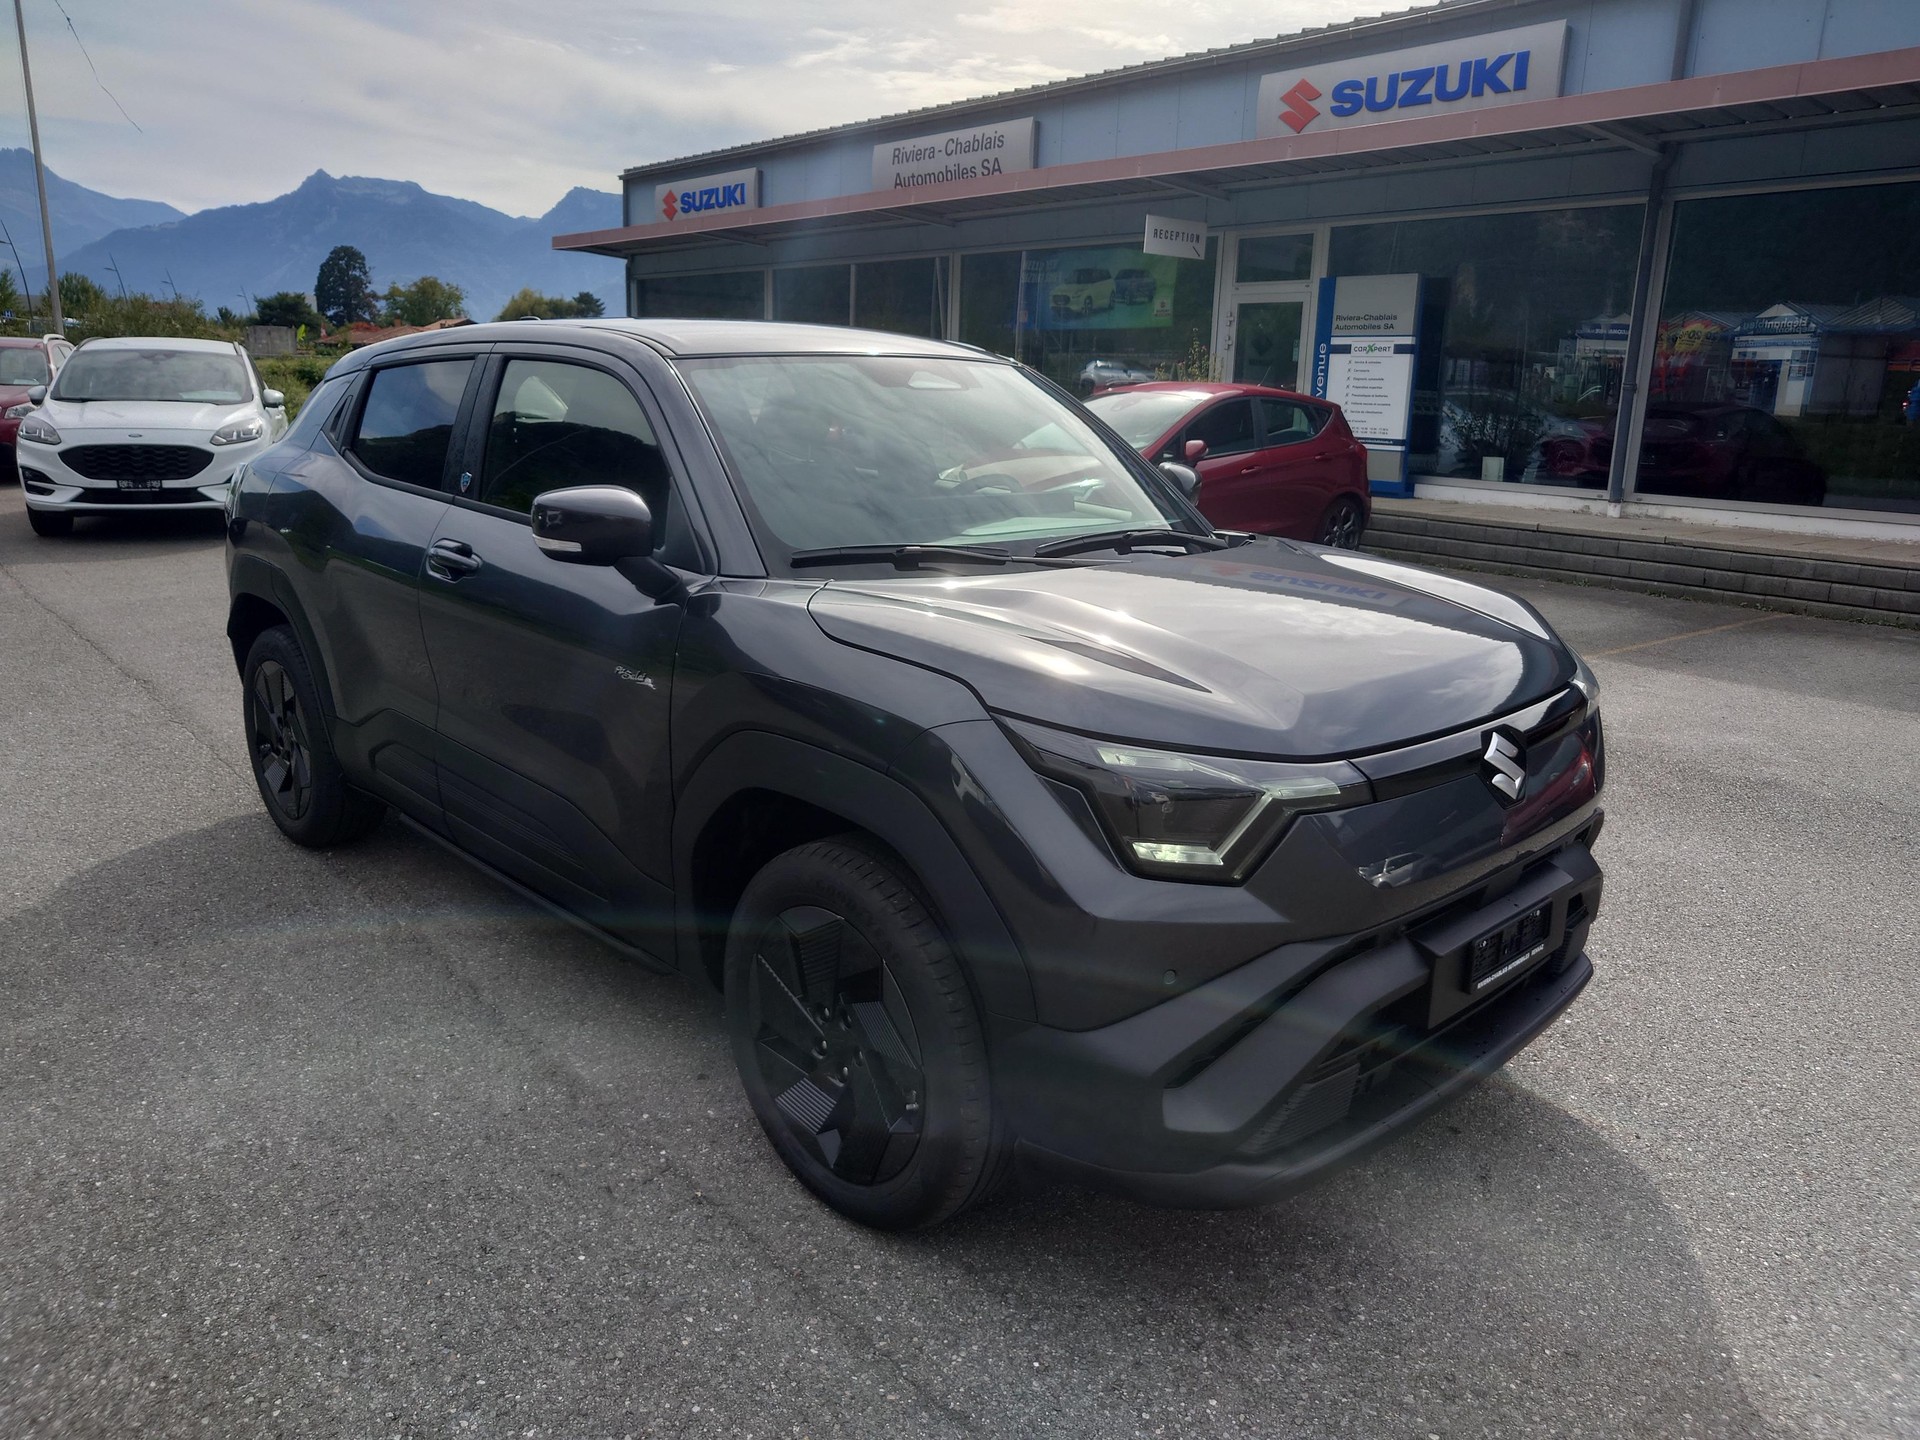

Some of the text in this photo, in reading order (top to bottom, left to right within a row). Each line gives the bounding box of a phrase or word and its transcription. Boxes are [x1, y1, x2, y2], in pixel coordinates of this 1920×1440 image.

[1330, 50, 1531, 117] SUZUKI
[894, 157, 1002, 189] Automobiles SA
[680, 182, 746, 213] SUZUKI
[1153, 228, 1200, 243] RECEPTION
[1316, 343, 1326, 397] venue
